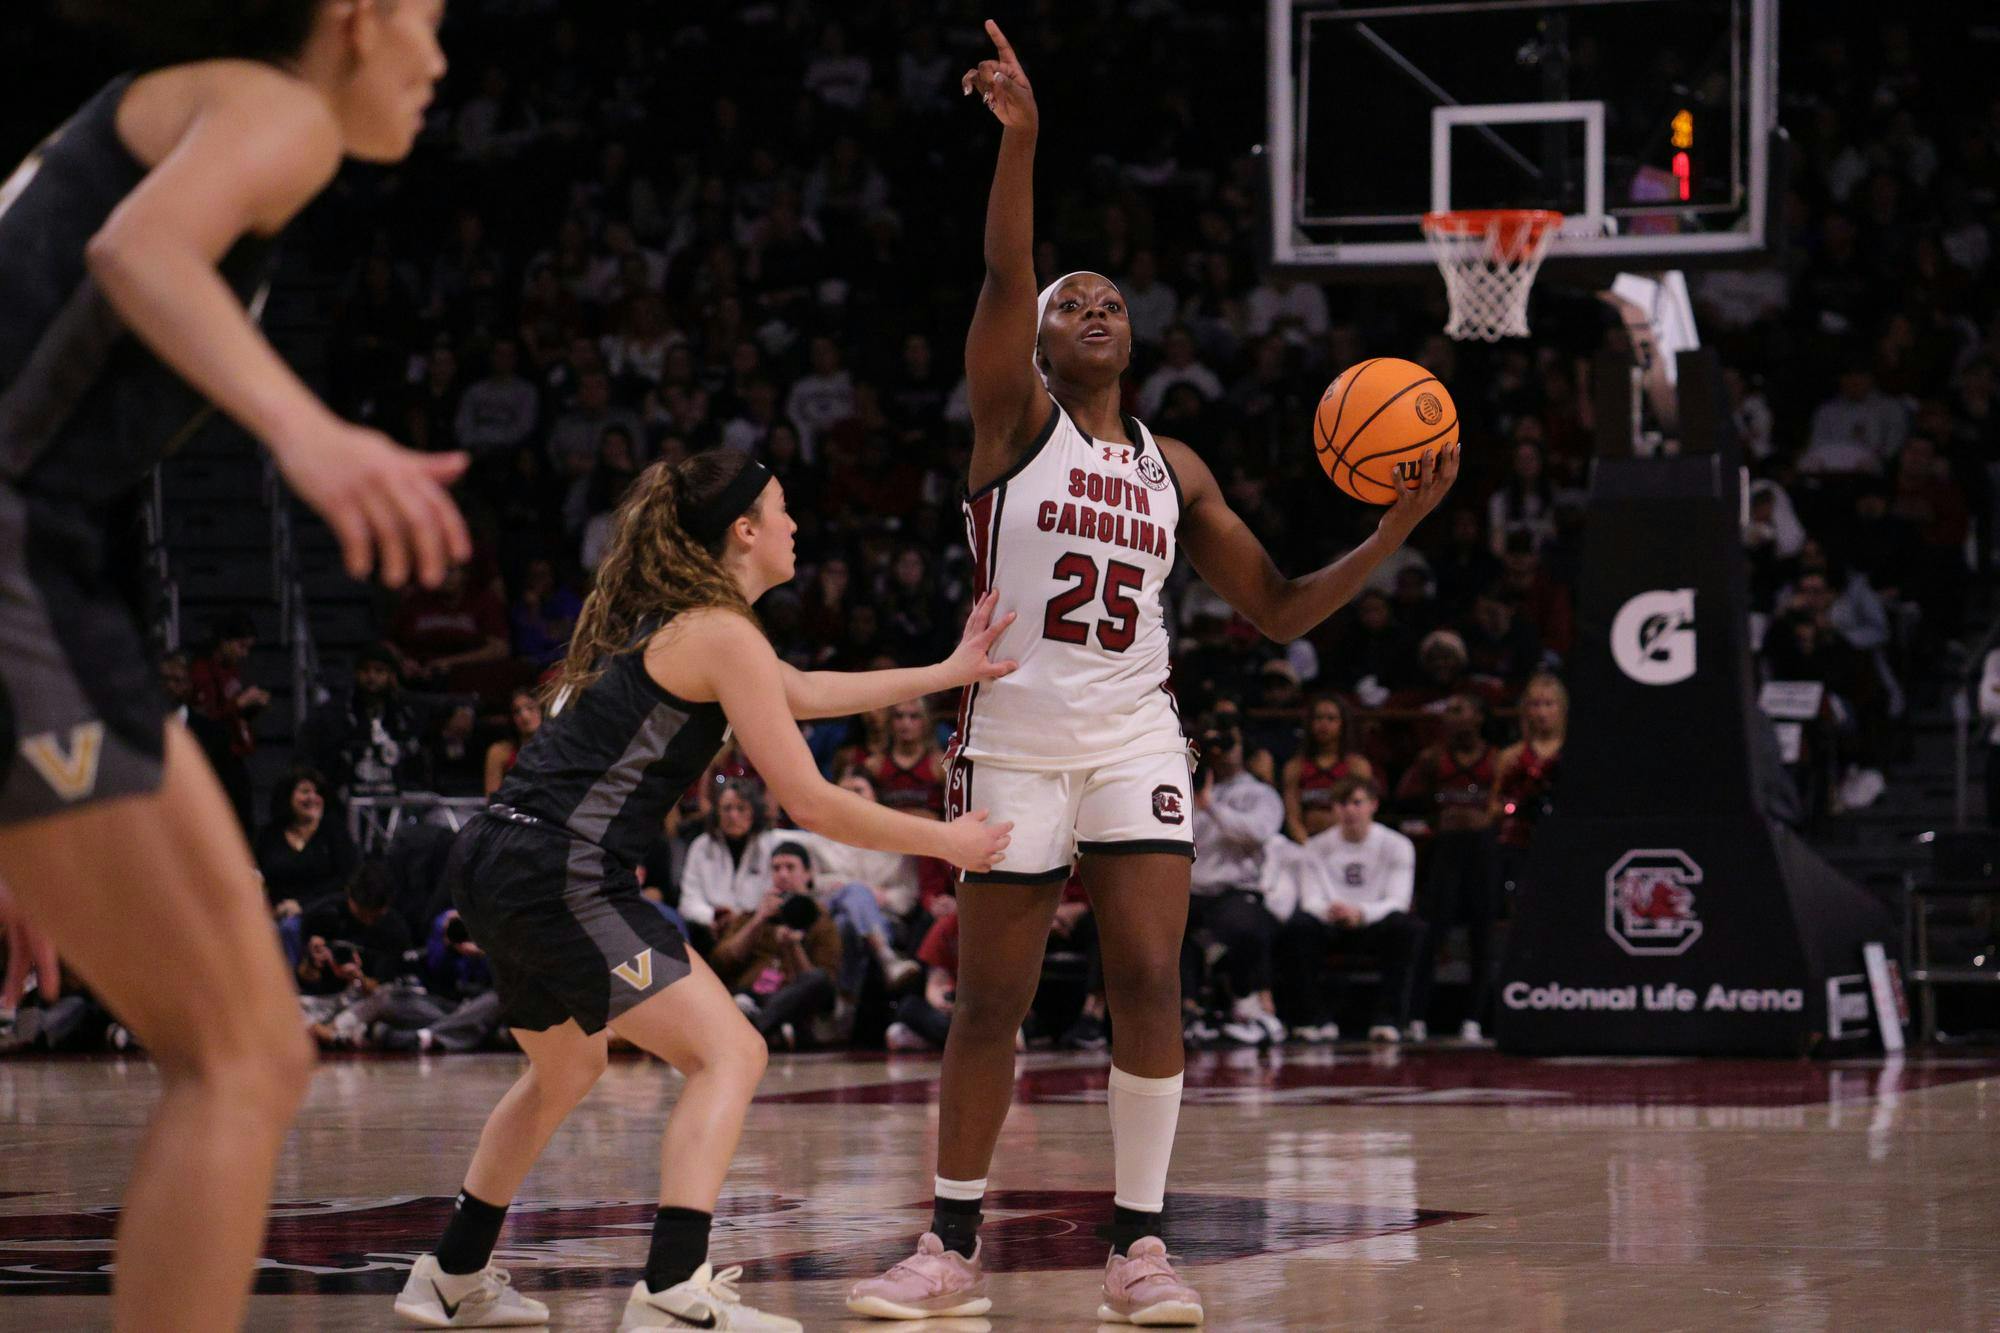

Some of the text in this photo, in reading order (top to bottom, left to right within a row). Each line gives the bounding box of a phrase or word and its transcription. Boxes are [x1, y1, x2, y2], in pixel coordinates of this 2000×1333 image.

[1068, 468, 1151, 516] SOUTH
[1037, 500, 1167, 560] CAROLINA
[1042, 551, 1146, 653] 25
[1610, 588, 1697, 686] G
[20, 721, 104, 801] V
[611, 947, 652, 991] V
[1502, 981, 1804, 1011] Colonial Life Arena
